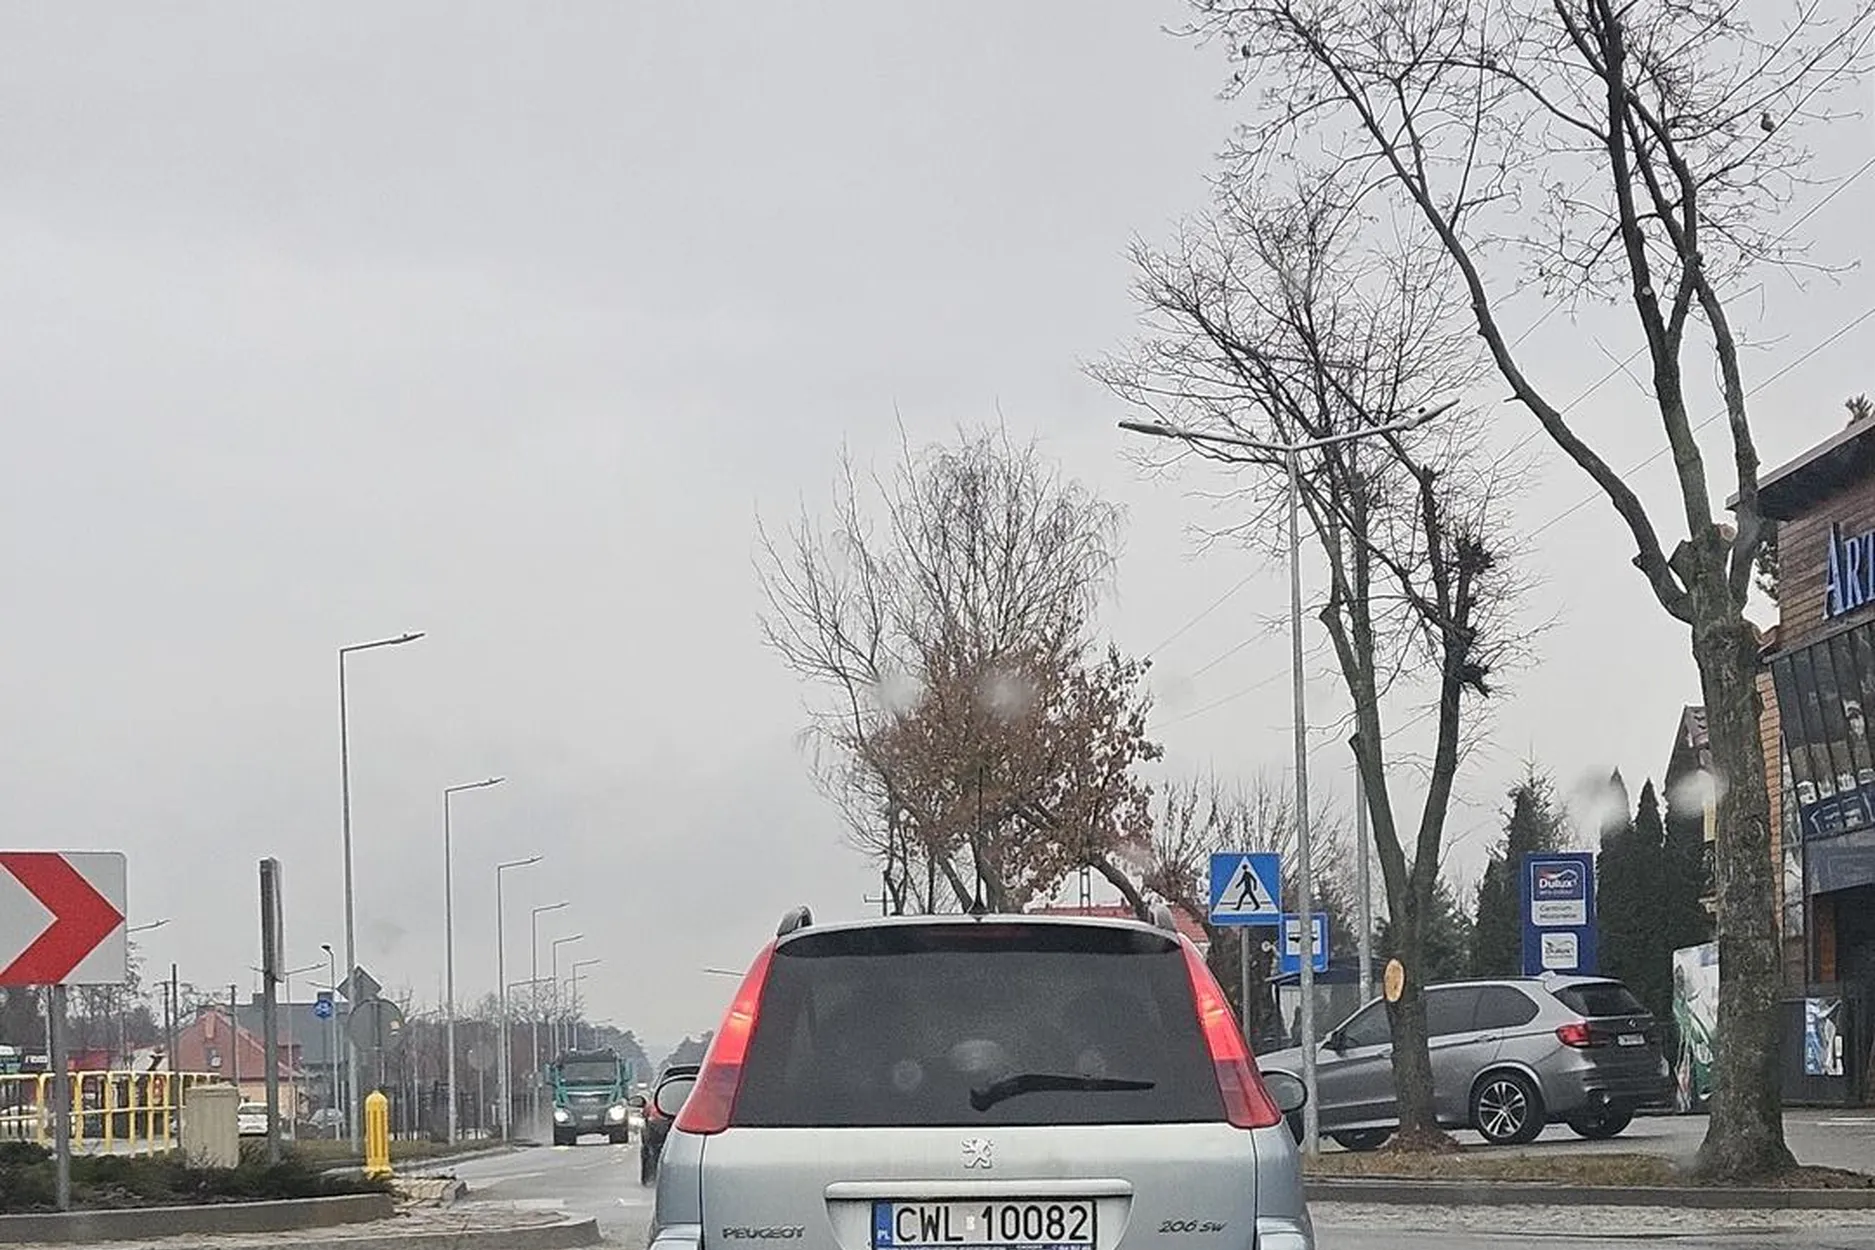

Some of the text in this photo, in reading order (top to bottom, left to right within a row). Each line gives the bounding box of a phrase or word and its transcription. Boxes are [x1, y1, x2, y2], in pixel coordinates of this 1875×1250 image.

[896, 1205, 1088, 1242] CWL 10082
[1158, 1219, 1197, 1233] 206
[722, 1226, 805, 1239] PEUGEOT
